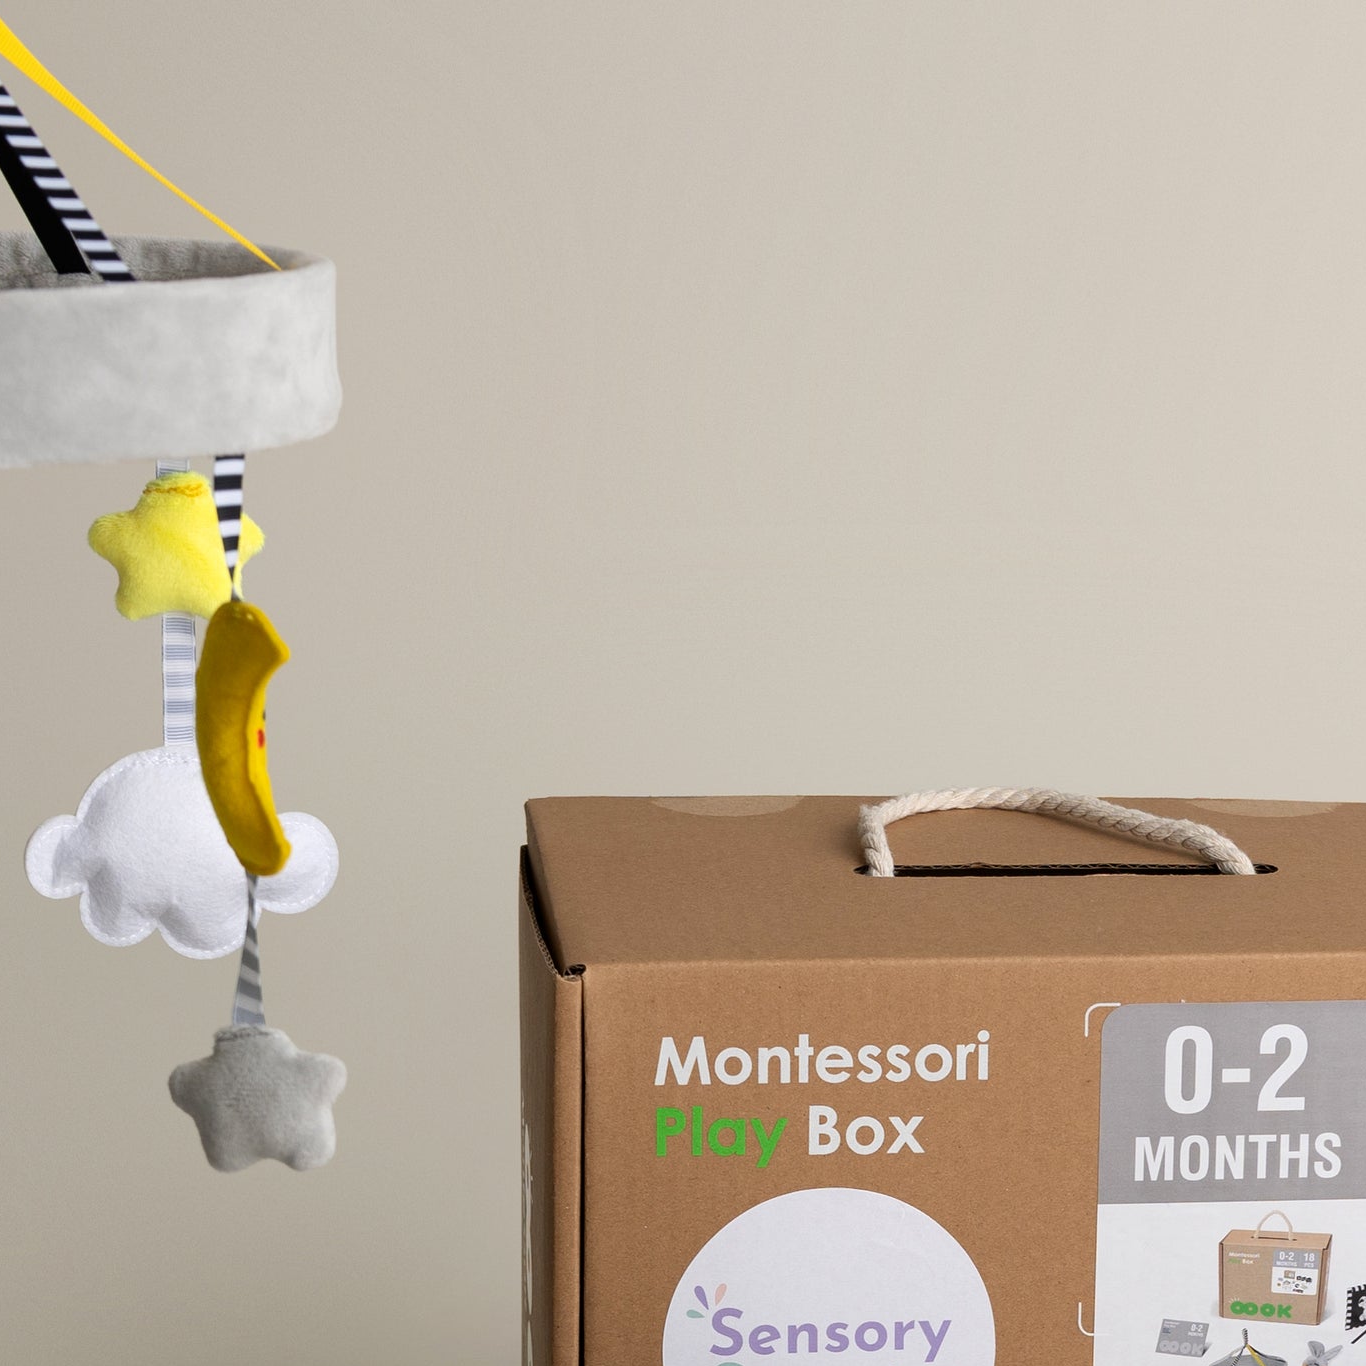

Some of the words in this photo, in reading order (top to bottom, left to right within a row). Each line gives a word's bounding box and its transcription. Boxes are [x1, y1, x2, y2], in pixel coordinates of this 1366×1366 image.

[654, 1030, 990, 1086] Montessori
[1164, 1023, 1309, 1114] 0-2
[655, 1106, 788, 1168] Play
[808, 1105, 925, 1155] Box
[1134, 1133, 1342, 1182] MONTHS
[1304, 1252, 1315, 1262] 18
[709, 1307, 952, 1363] Sensory
